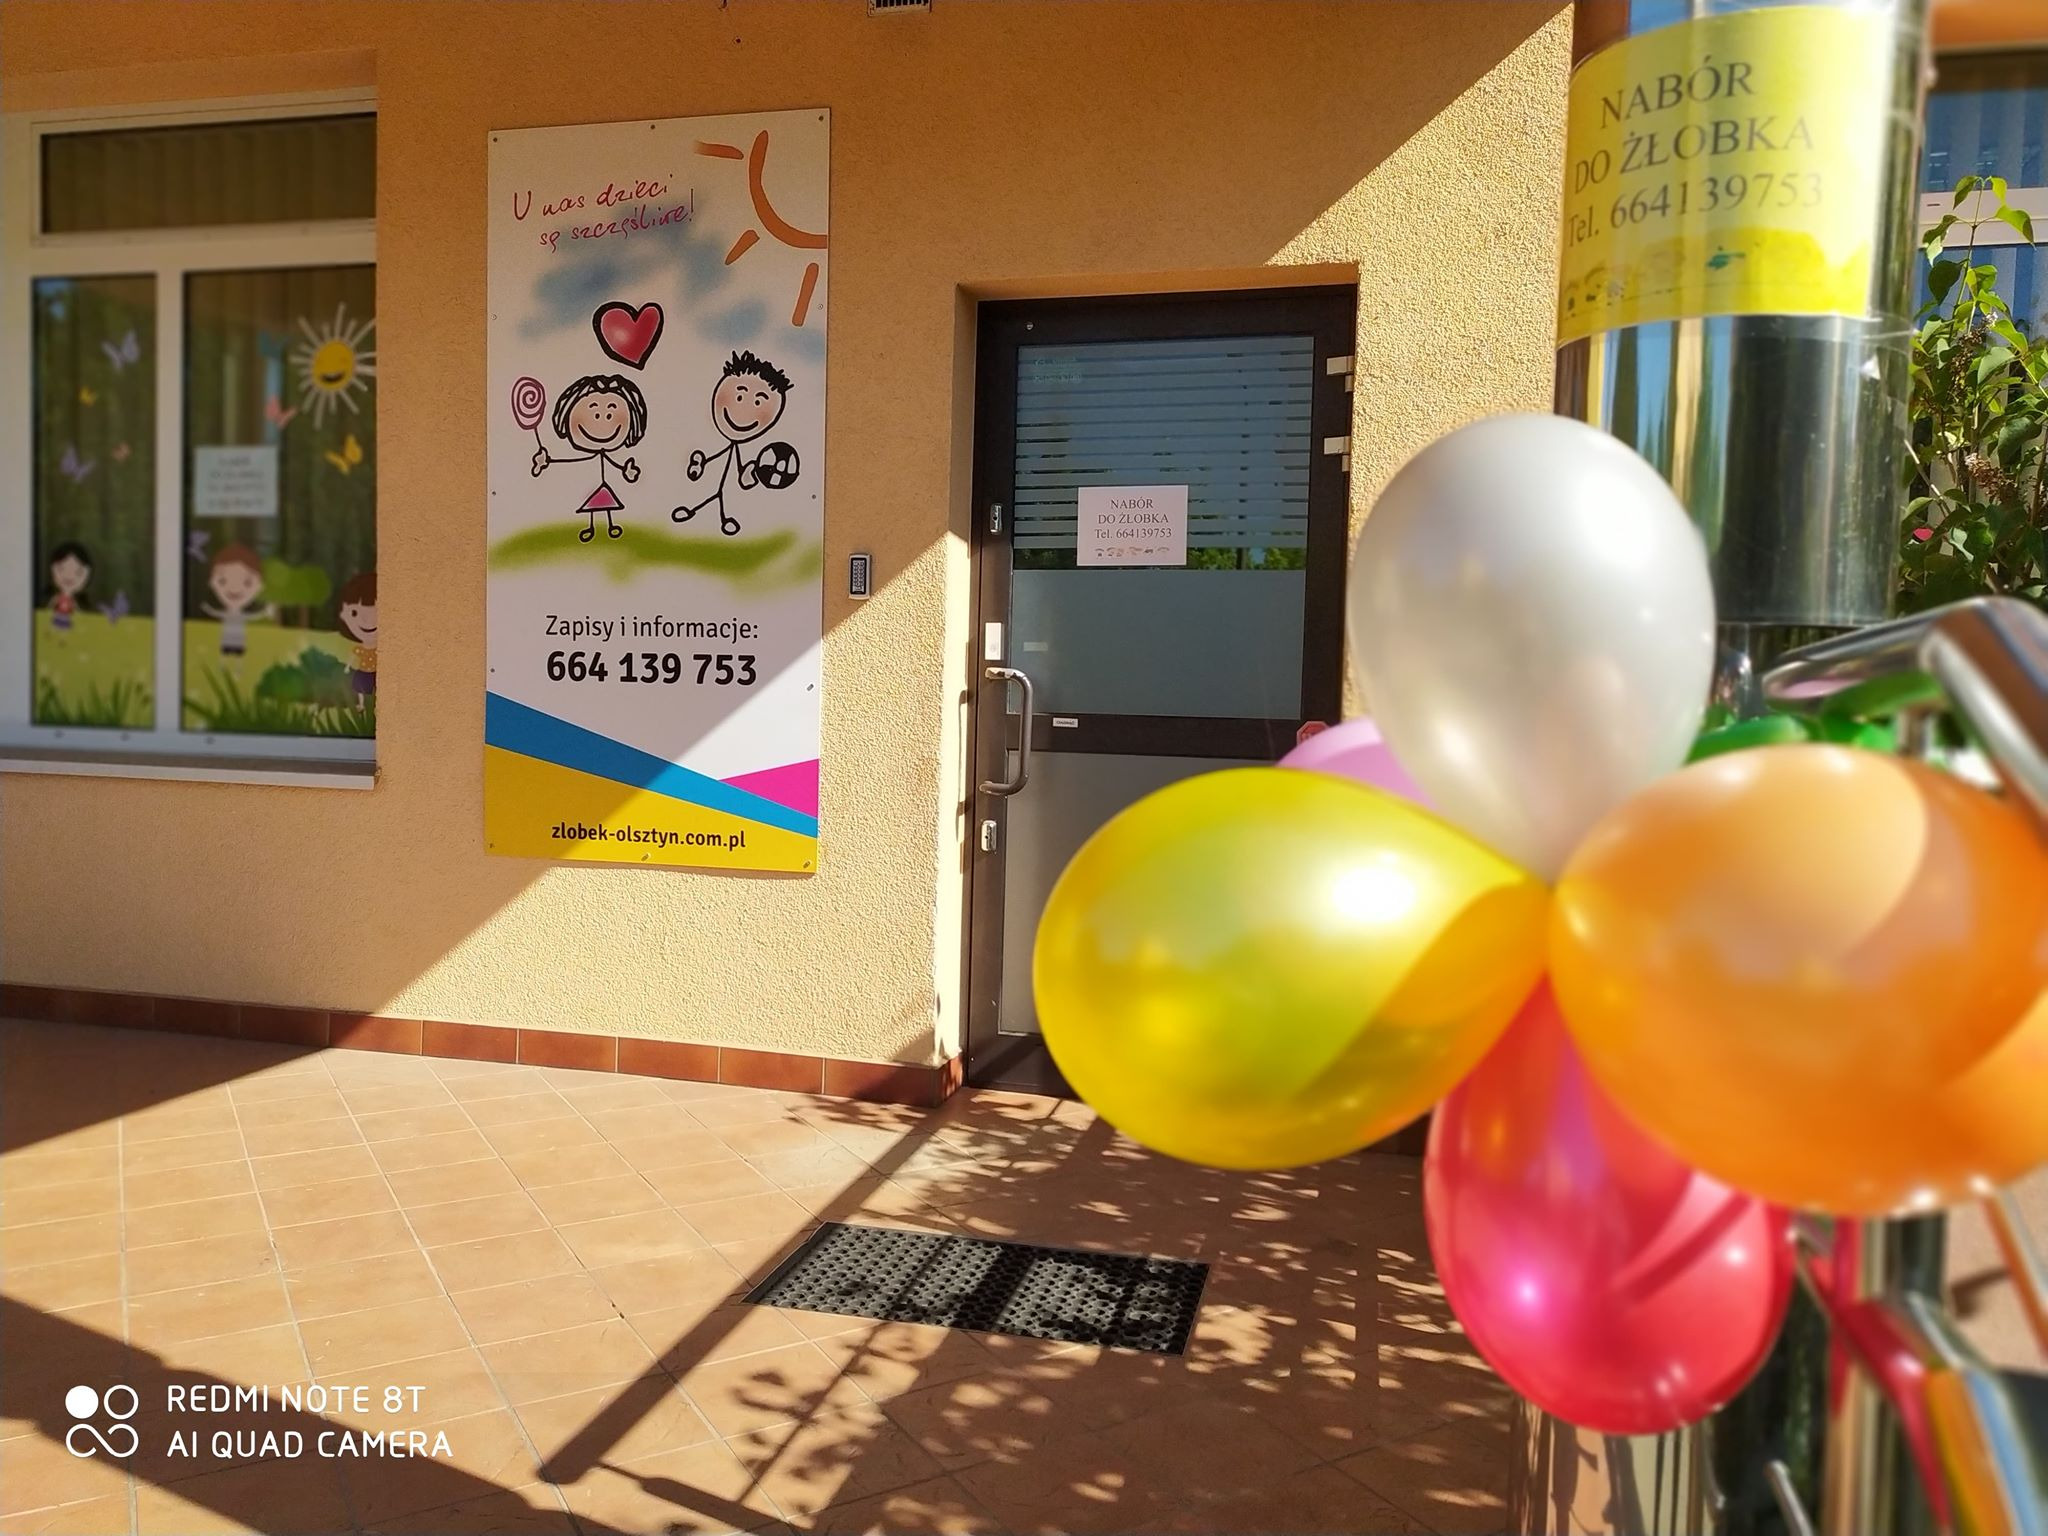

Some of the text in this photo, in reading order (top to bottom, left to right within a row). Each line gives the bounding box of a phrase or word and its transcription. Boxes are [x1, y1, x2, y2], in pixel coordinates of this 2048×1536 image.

[1600, 55, 1757, 129] NABÓR
[1574, 115, 1815, 195] DO ŻŁOBKA
[513, 173, 674, 221] U nas dzieci
[1568, 171, 1823, 247] Tel. 664139753
[1098, 512, 1169, 525] DO ŻŁOBKA
[1110, 497, 1154, 509] NABÓR
[1094, 527, 1172, 539] Tel. 664139753
[545, 614, 759, 645] Zapisy i informacje:
[547, 651, 757, 686] 664 139 753
[551, 822, 746, 851] zlobek-olsztyn.com.pl
